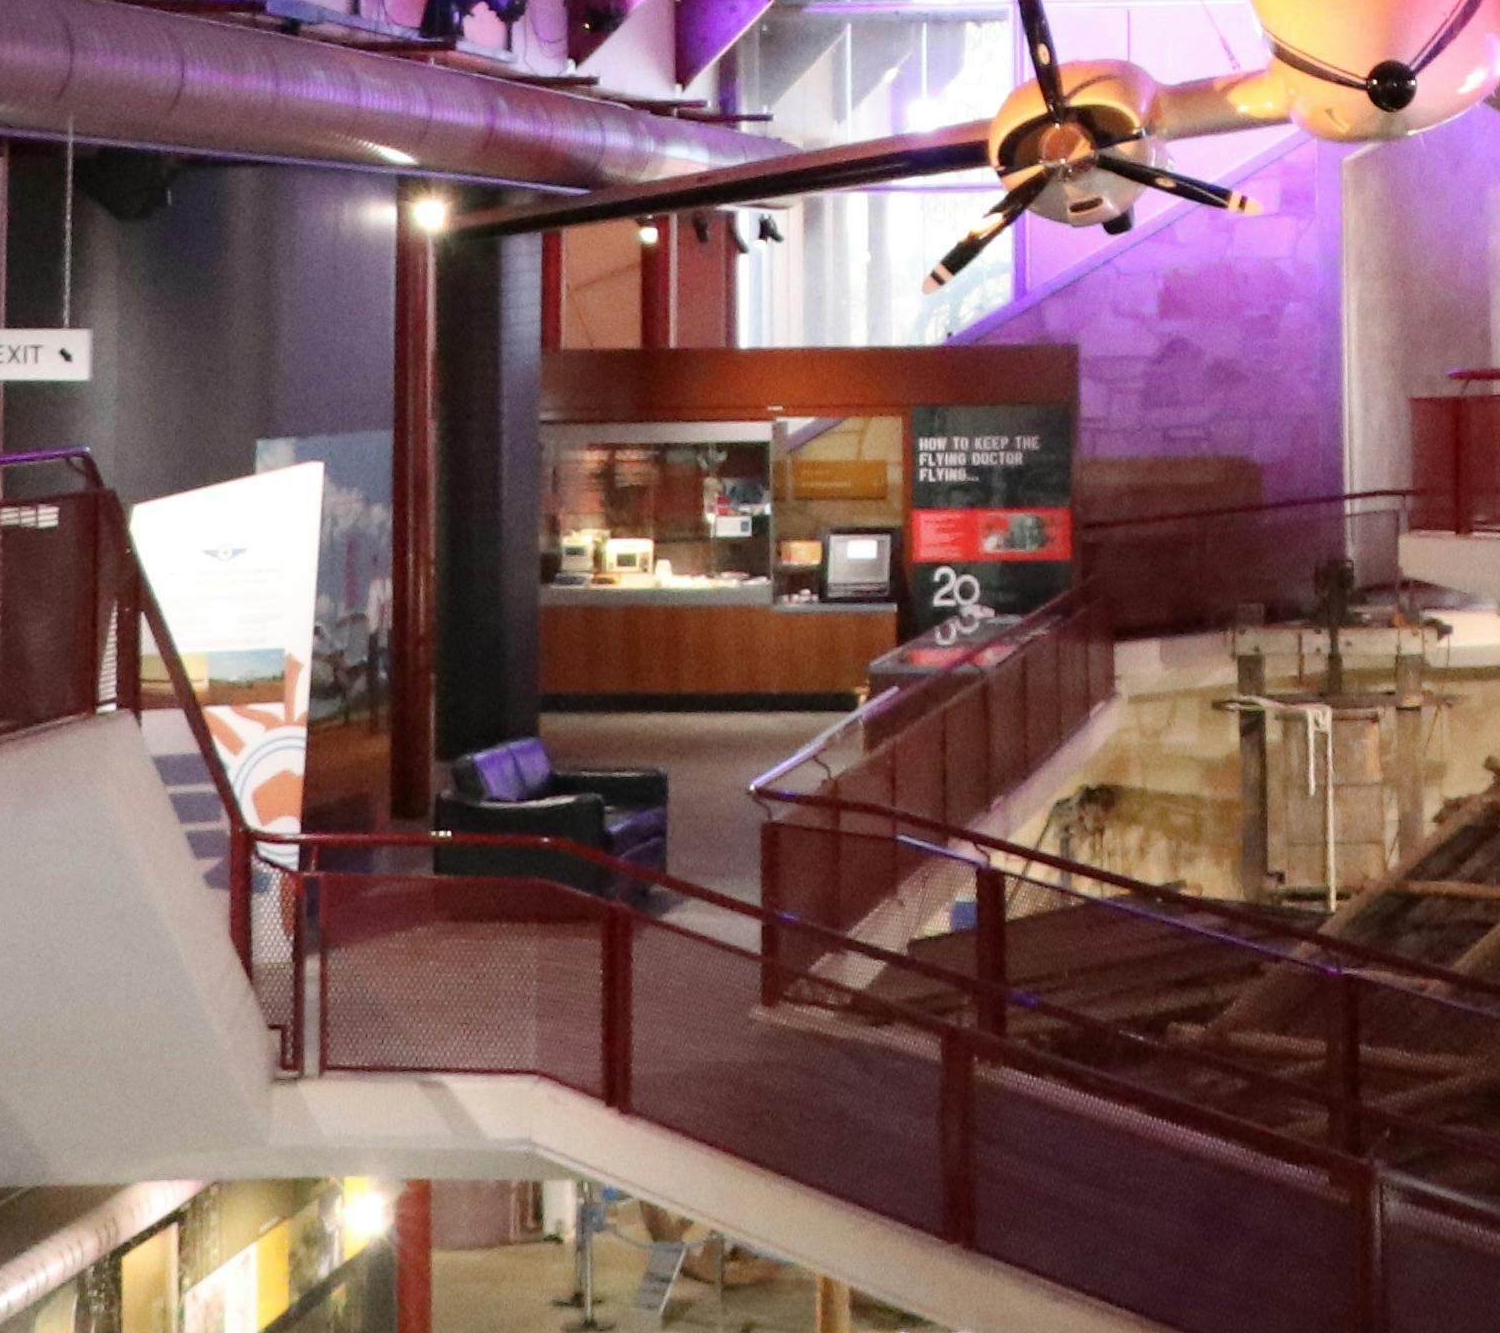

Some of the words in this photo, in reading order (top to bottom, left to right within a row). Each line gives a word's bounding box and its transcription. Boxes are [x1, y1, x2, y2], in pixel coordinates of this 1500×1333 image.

[918, 436, 950, 451] HOW
[953, 436, 969, 451] TO
[974, 436, 1009, 451] KEEP
[1014, 435, 1041, 450] THE
[918, 451, 966, 466] FLYING
[972, 451, 1024, 466] DOCTOR
